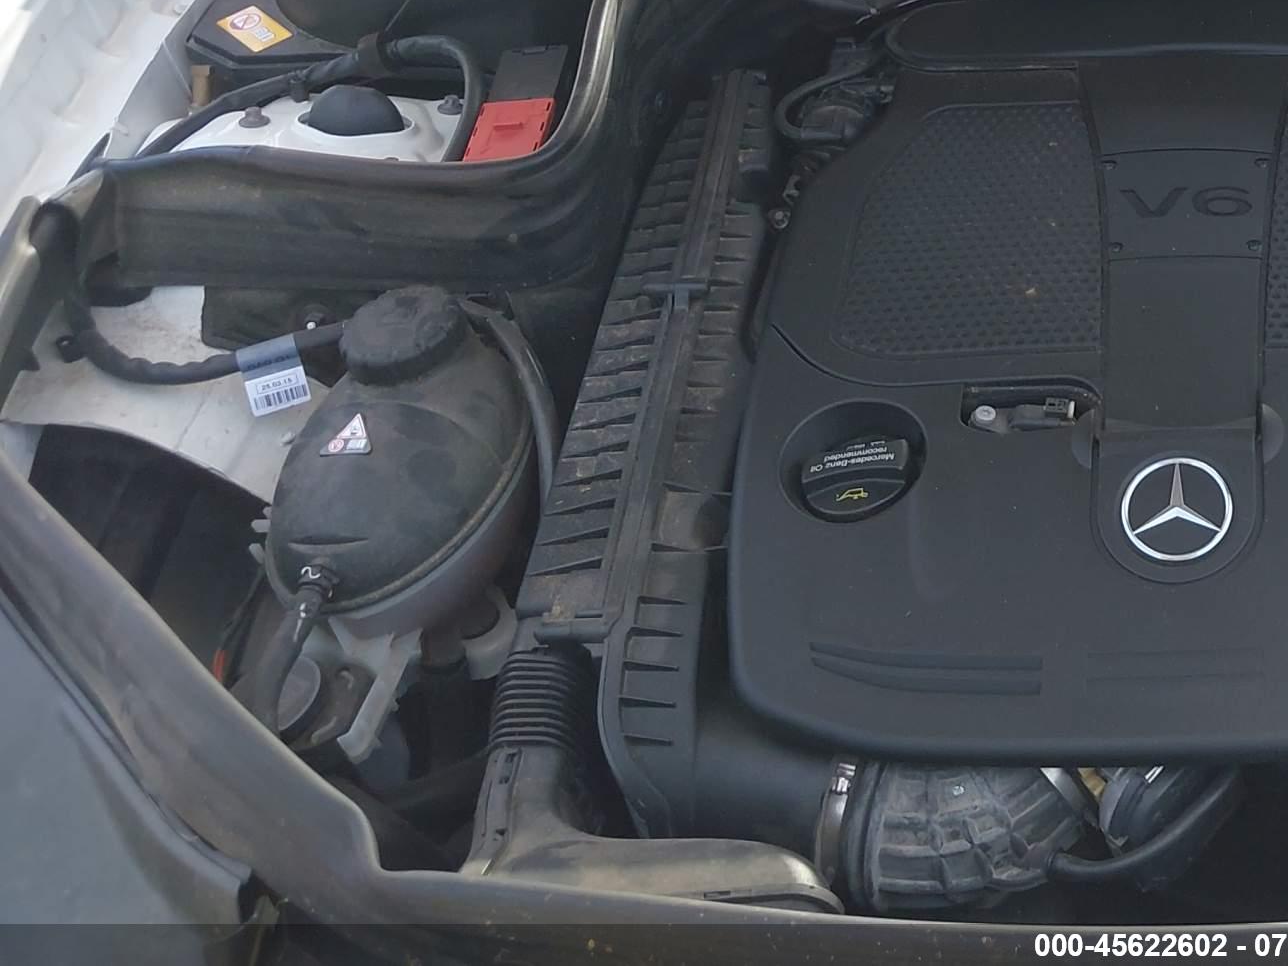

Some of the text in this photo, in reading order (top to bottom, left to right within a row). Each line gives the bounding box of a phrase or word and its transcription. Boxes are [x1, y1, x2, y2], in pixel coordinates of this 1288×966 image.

[1120, 186, 1252, 218] V6
[810, 452, 895, 473] Mercedes-Benz Oil
[824, 446, 887, 463] recommended
